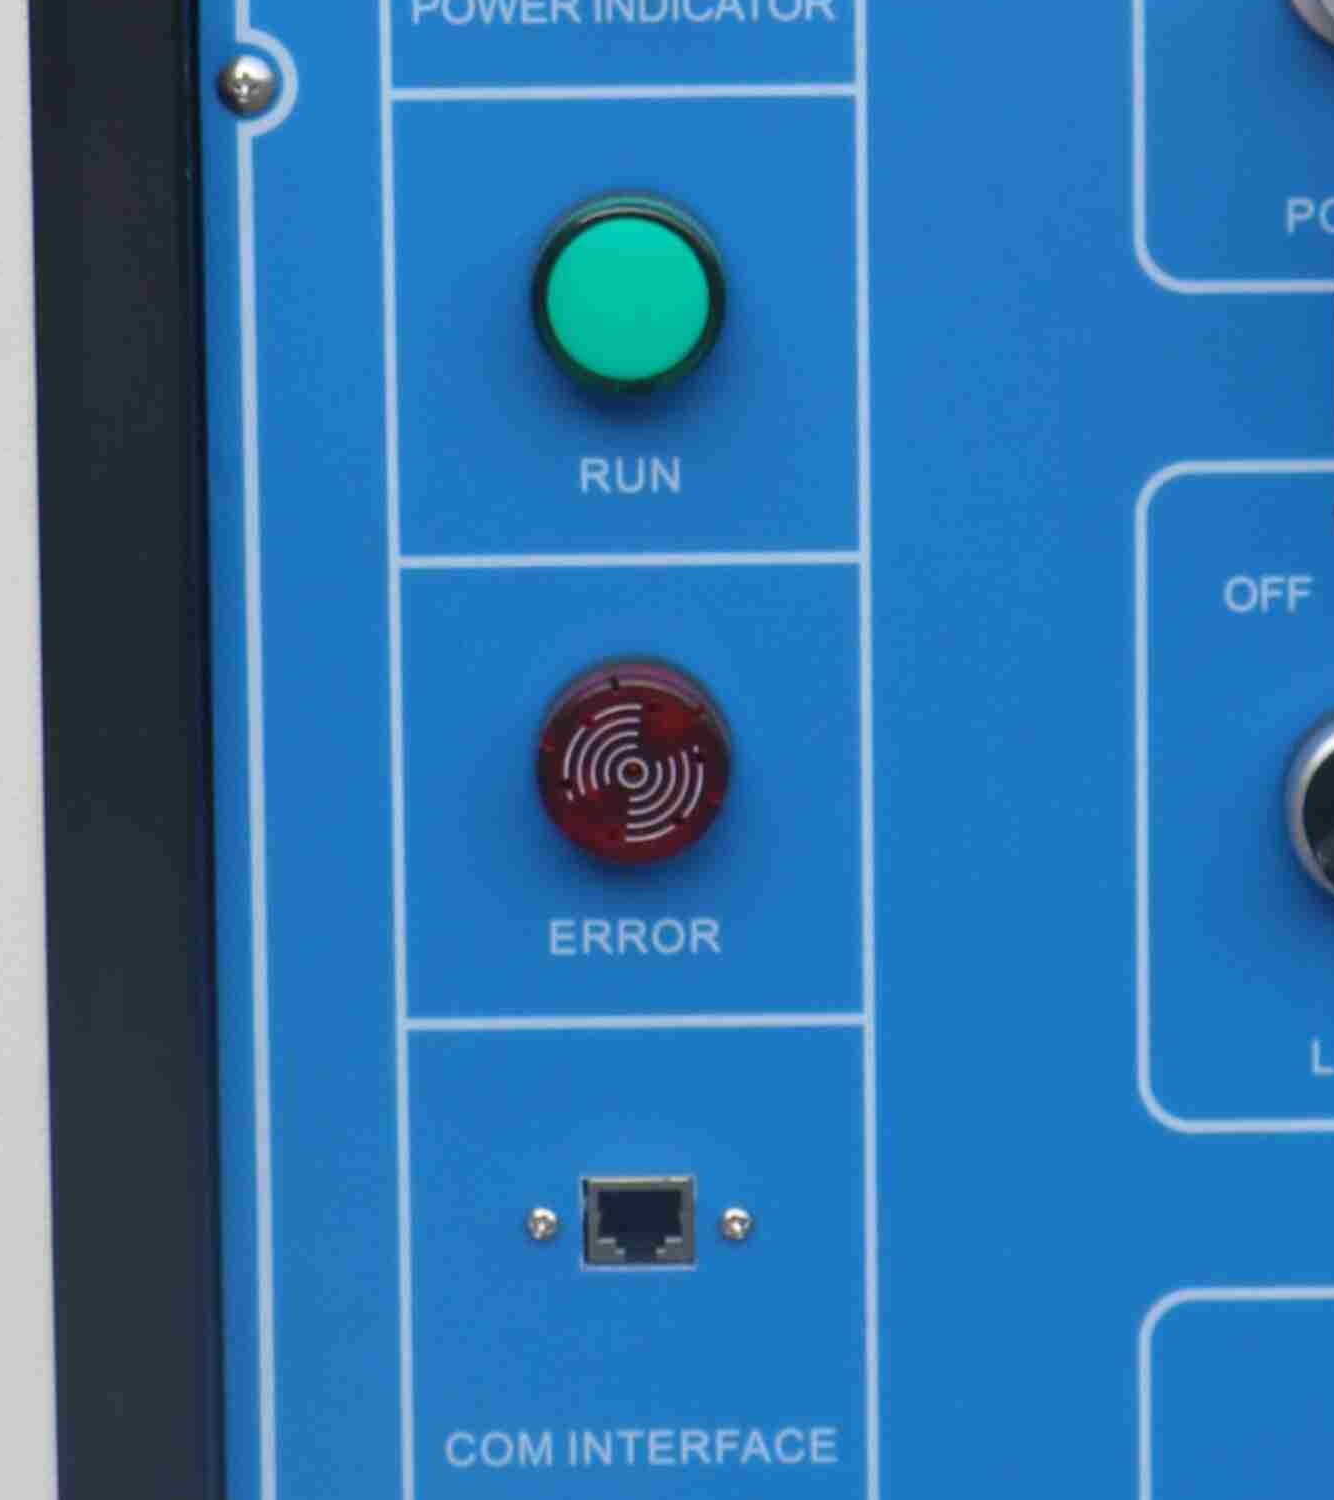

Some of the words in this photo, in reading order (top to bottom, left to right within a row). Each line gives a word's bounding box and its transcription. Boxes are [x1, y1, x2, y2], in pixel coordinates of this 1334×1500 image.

[580, 456, 681, 494] RUN
[1223, 574, 1314, 613] OFF
[548, 917, 721, 956] ERROR
[444, 1430, 554, 1468] COM
[568, 1426, 839, 1465] INTERFACE
